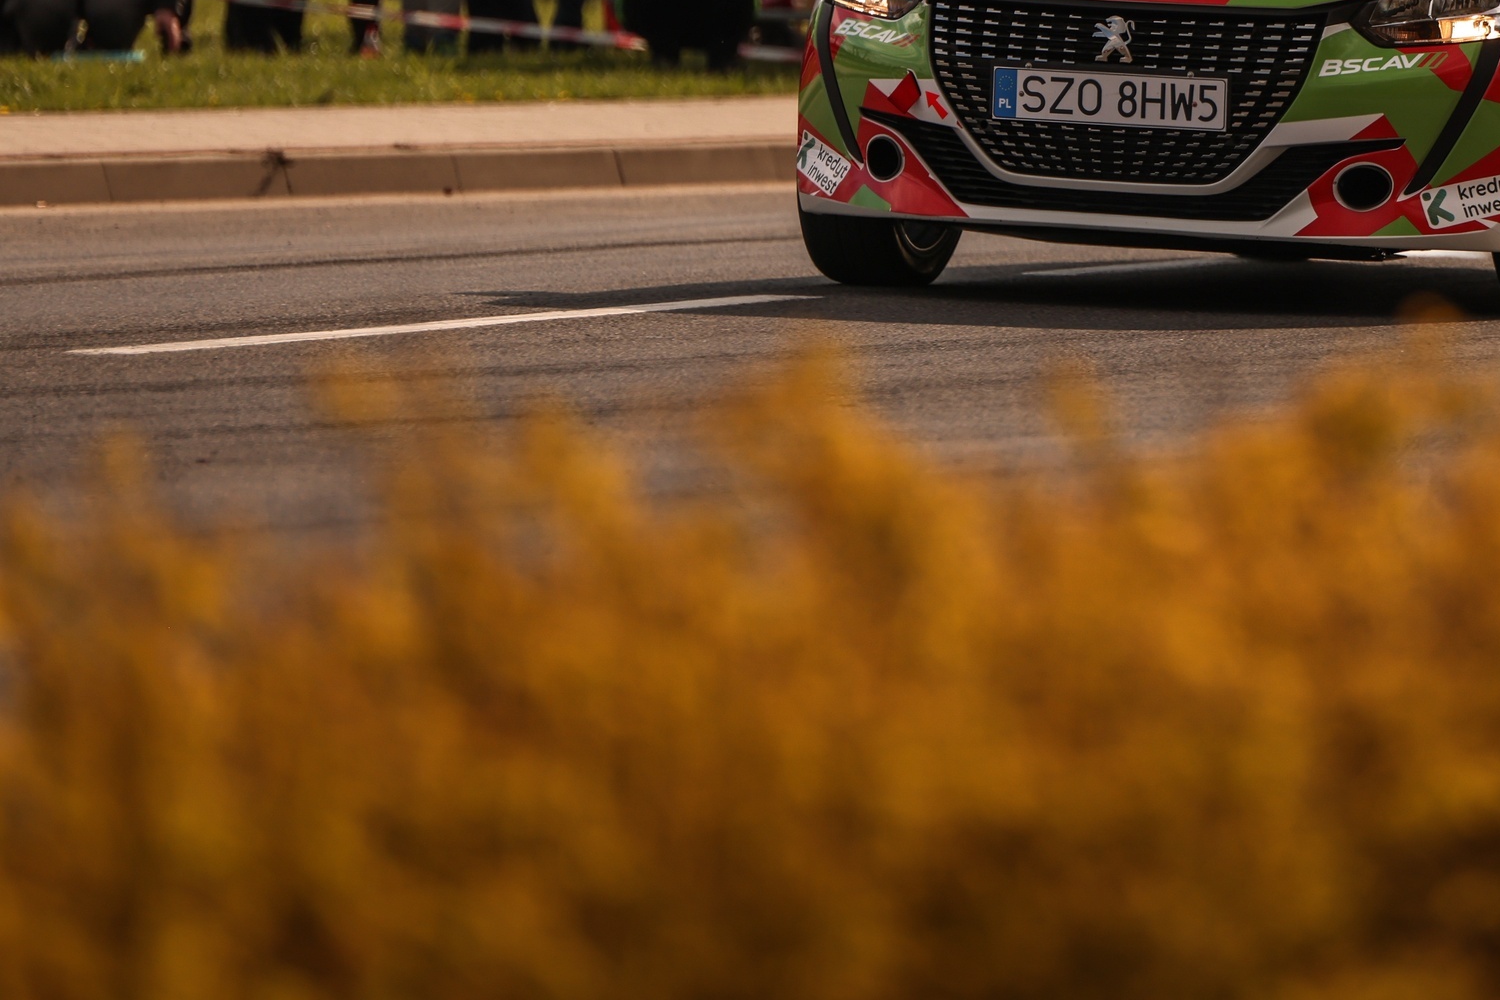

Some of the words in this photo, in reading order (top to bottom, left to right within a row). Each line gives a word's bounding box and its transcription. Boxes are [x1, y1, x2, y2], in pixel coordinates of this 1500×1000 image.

[834, 18, 909, 44] BSCAV
[1318, 52, 1426, 78] BSCAV
[998, 98, 1012, 109] PL
[1022, 75, 1102, 116] SZO
[1117, 80, 1218, 122] 8HW5
[816, 143, 849, 179] kredyt
[806, 160, 838, 194] inwest
